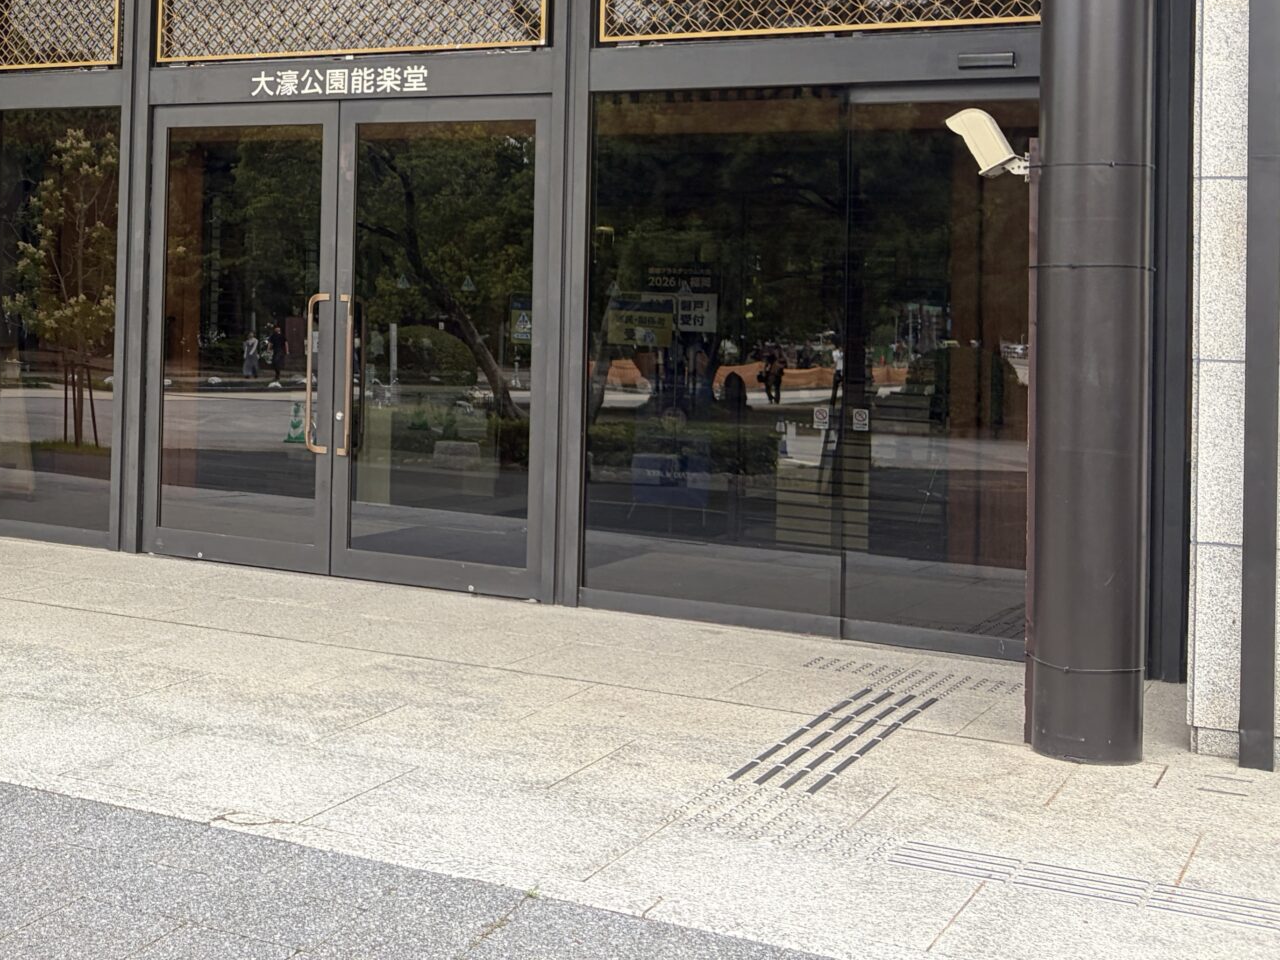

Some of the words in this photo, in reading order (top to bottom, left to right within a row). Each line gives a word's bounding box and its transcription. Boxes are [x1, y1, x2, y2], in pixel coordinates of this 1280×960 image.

[250, 65, 428, 97] 大濠公園能楽堂
[648, 276, 677, 287] 2026
